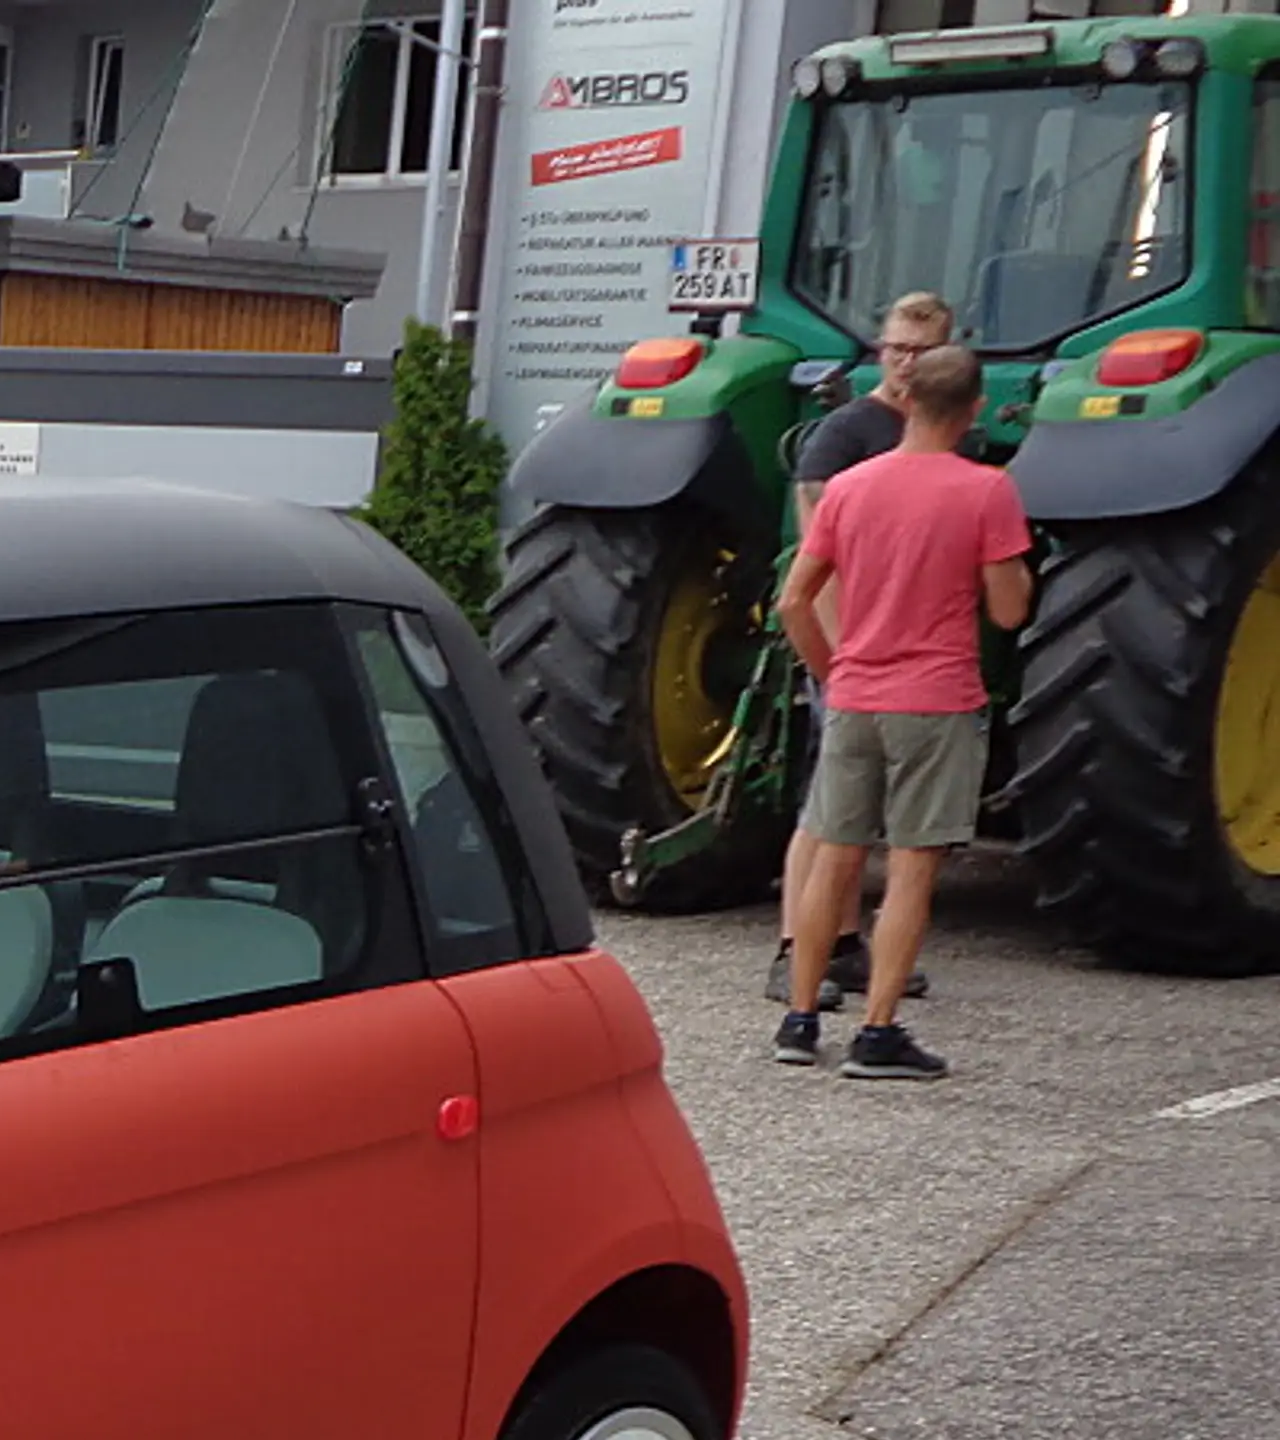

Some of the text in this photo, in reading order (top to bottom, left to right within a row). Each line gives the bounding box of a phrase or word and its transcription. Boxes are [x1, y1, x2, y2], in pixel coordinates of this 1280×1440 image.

[537, 70, 689, 110] AMBROS
[696, 247, 725, 270] FR
[674, 273, 751, 299] 259 AT
